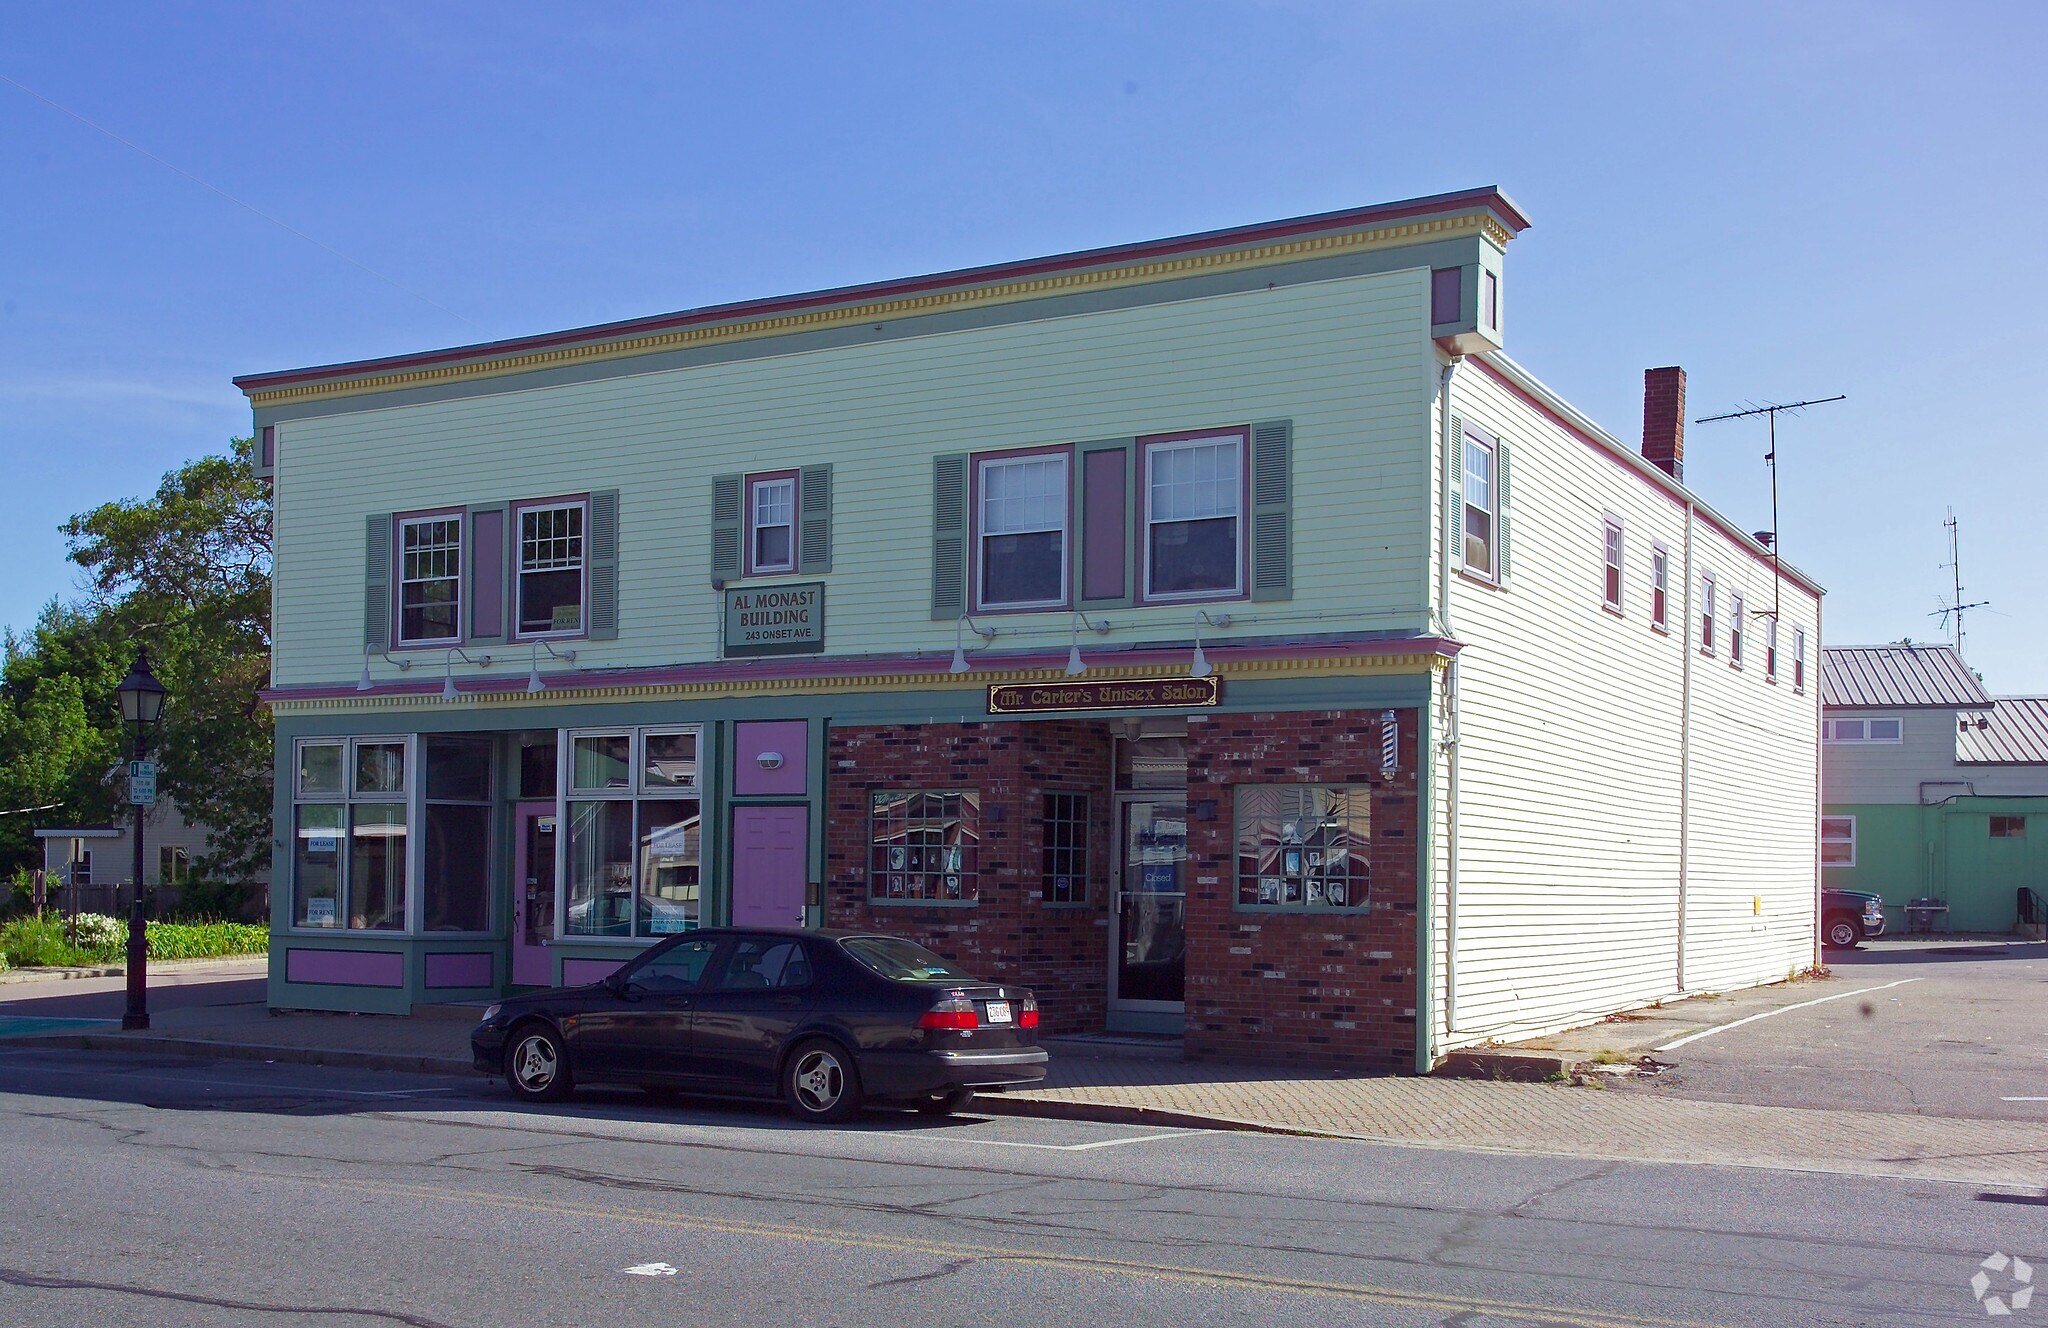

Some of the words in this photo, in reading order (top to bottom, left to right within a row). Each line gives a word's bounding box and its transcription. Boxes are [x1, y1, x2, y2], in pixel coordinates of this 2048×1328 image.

[734, 595, 751, 610] AL
[755, 591, 816, 609] MONAST
[740, 609, 809, 627] BUILDING
[745, 631, 760, 641] 243
[762, 629, 793, 640] ONSET
[794, 628, 814, 638] AVE.
[1000, 691, 1025, 706] Mr.
[1031, 688, 1093, 705] Carter's
[1099, 687, 1156, 703] Unisex
[1161, 684, 1207, 700] Salon
[1145, 873, 1171, 882] Closed
